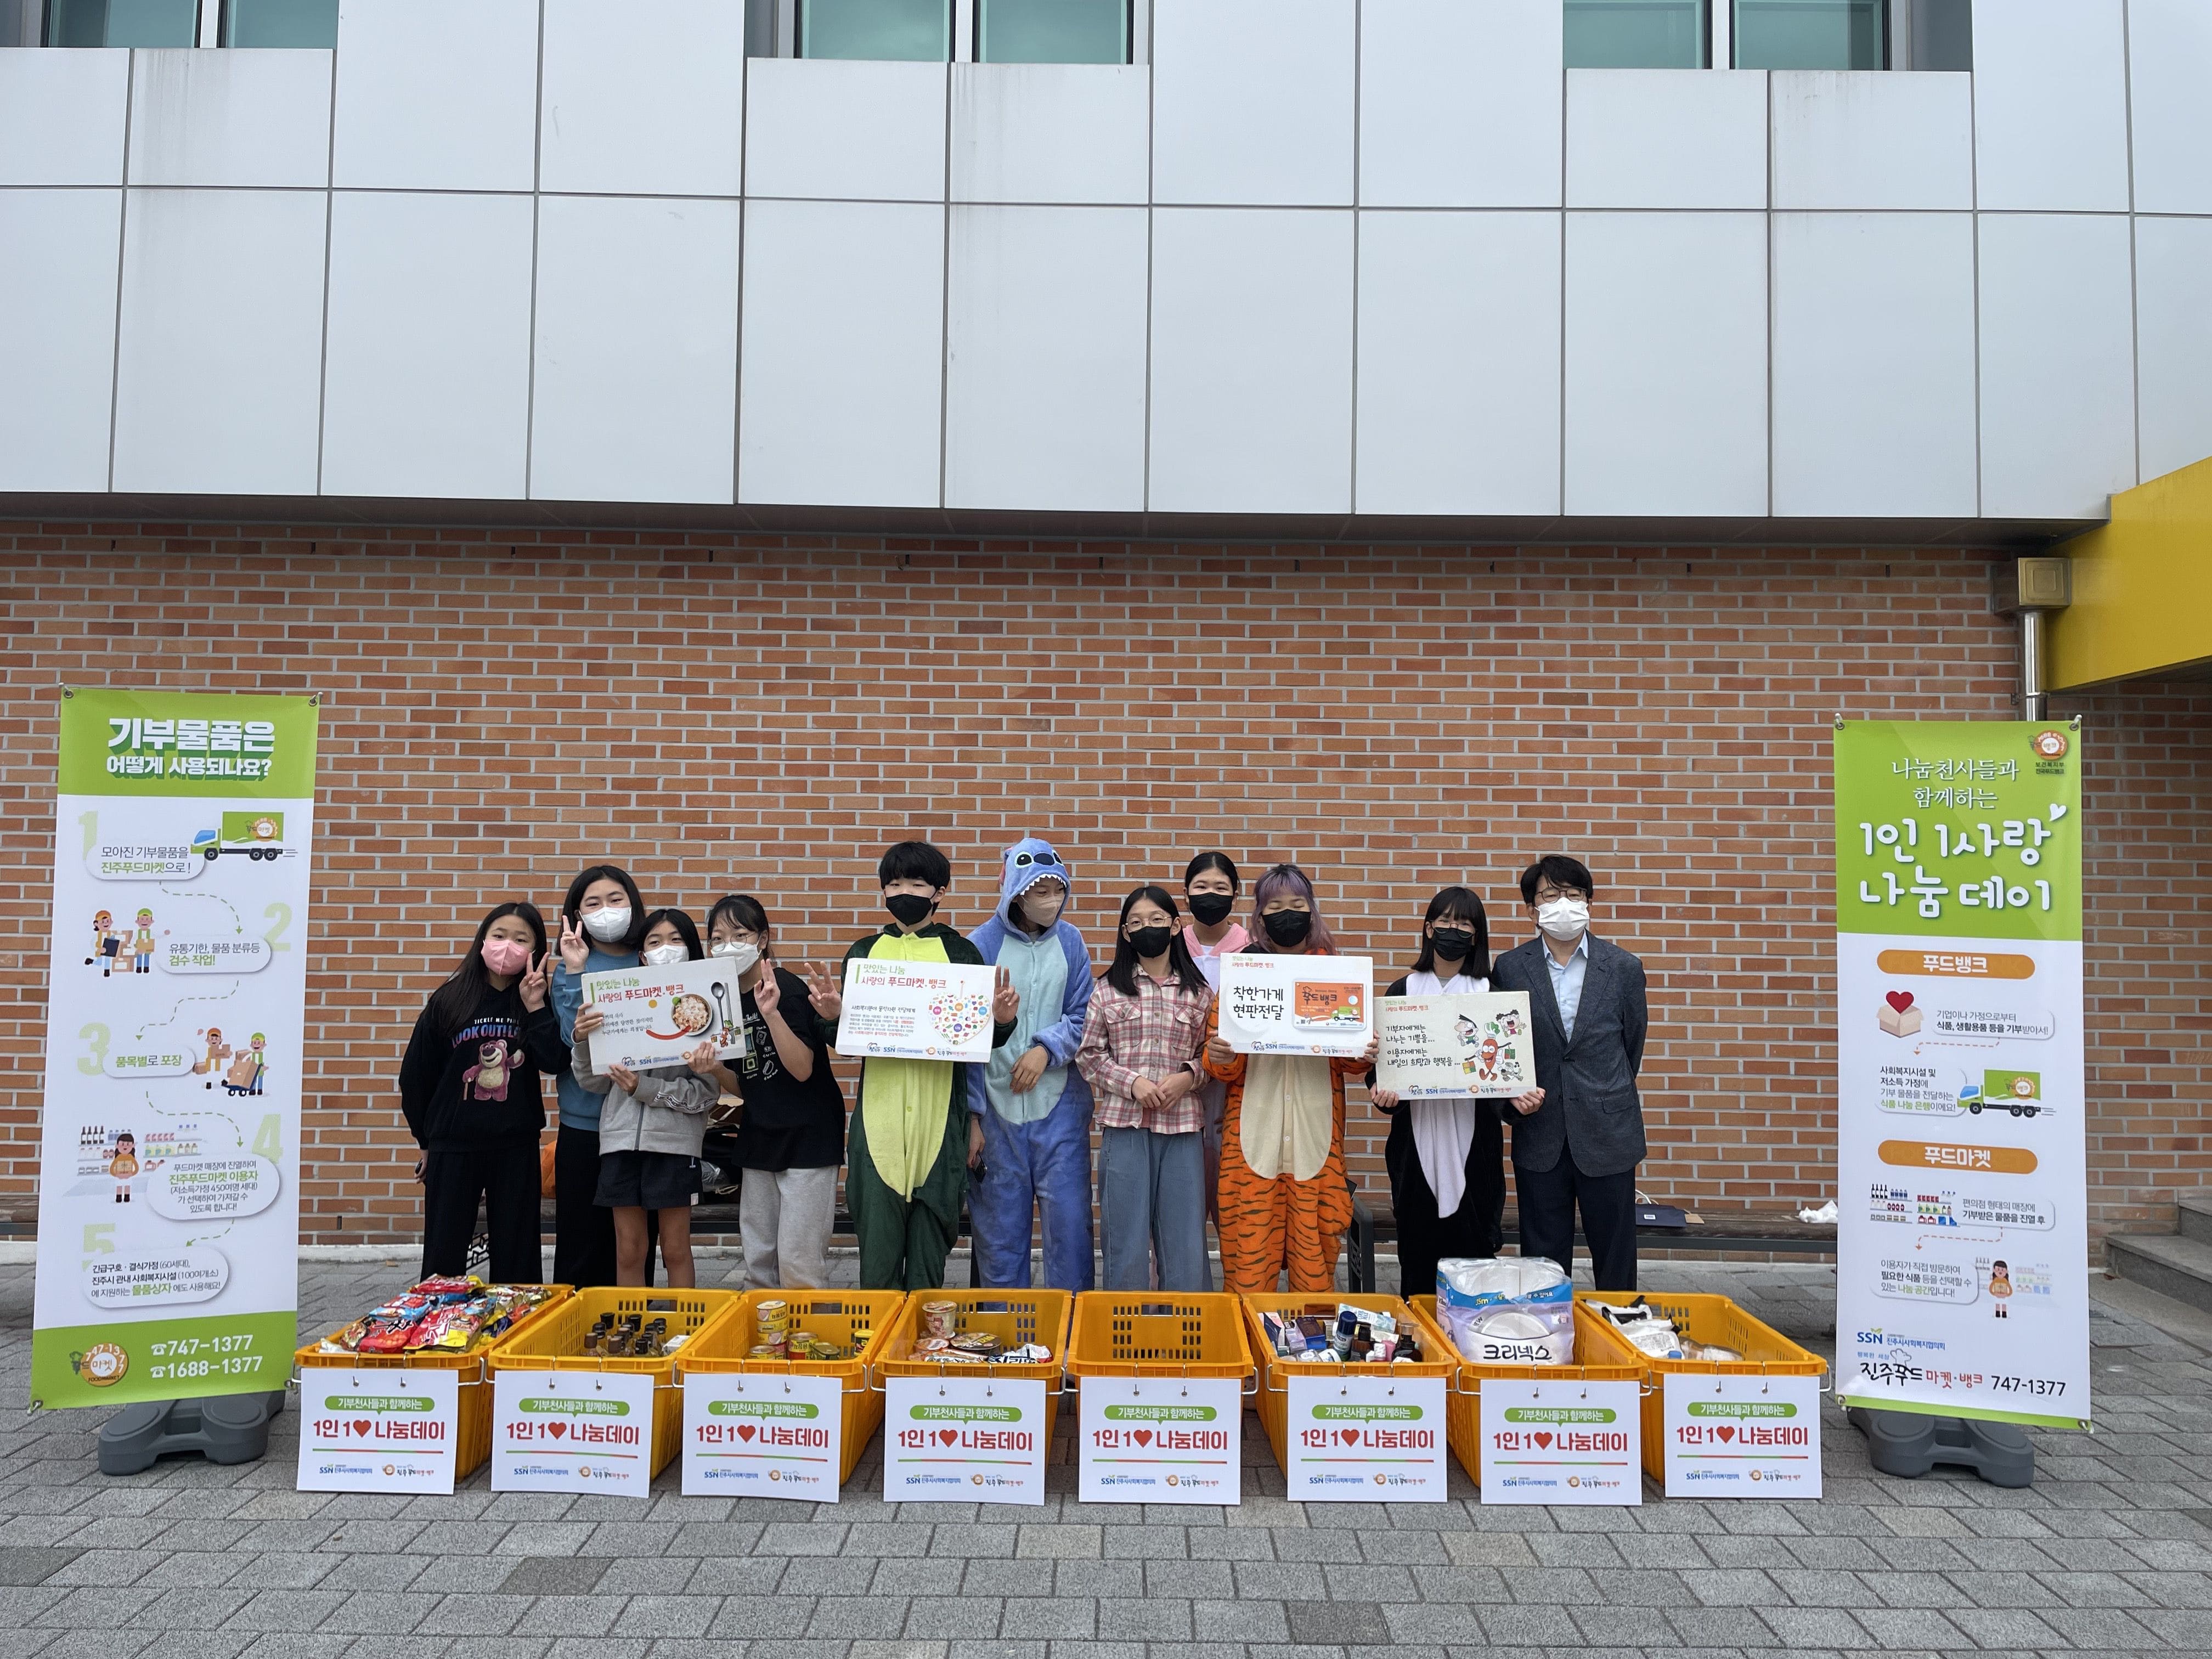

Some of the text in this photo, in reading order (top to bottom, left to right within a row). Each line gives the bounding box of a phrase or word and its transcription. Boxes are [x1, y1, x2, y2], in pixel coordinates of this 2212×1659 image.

[108, 718, 275, 753] 기부물품은
[107, 757, 272, 776] 어떻게 사용되나요?
[1892, 758, 2019, 781] 나눔천사들과
[1913, 787, 1999, 809] 함께하는
[1860, 818, 2051, 866] 1인 1사랑
[101, 847, 189, 859] 모아진 기부물품을
[1860, 865, 2051, 918] 나눔 데이
[169, 943, 260, 954] 유통기한, 물품 분류등
[170, 955, 215, 966] 검수 작업!
[1923, 955, 1988, 973] 푸드뱅크
[864, 964, 905, 975] 맛있는 나눔
[597, 977, 640, 990] 맛있는 나눔
[861, 977, 885, 985] 사랑의
[598, 992, 622, 1003] 사랑의
[1233, 986, 1283, 1001] 착한가게
[1233, 1005, 1284, 1020] 현판전달
[1937, 1011, 2016, 1022] 기업이나 가정으로부터
[1386, 1024, 1426, 1033] 기부자에게는
[1937, 1021, 2048, 1035] 식품, 생활용품 등을 기부받아서!
[452, 1026, 479, 1048] LOOK
[1386, 1035, 1406, 1044] 나누는
[1387, 1048, 1427, 1057] 이용자에게는
[116, 1055, 182, 1068] 품목별로 포장
[1387, 1059, 1408, 1068] 내일의
[1410, 1058, 1431, 1066] 희망과
[1881, 1066, 1936, 1077] 사회복지시설 및
[1881, 1077, 1928, 1088] 저소득 가정에
[1881, 1088, 1895, 1098] 기부
[1898, 1089, 1921, 1099] 물품을
[1881, 1099, 1956, 1112] 식품 나눔 은행이에요!
[1925, 1146, 1991, 1168] 푸드마켓
[174, 1163, 202, 1172] 푸드마켓
[205, 1162, 226, 1171] 매장에
[169, 1170, 258, 1185] 진주푸드마켓 이용자
[178, 1195, 185, 1204] 가
[187, 1194, 216, 1204] 선택하여
[240, 1193, 248, 1201] 수
[1963, 1198, 2035, 1212] 편의점 형태의 매장에
[190, 1203, 237, 1214] 있도록 합니다!
[1963, 1210, 1994, 1221] 기부받은
[1995, 1212, 2018, 1222] 물품을
[2037, 1215, 2045, 1224] 후
[93, 1264, 122, 1274] 긴급구호
[1881, 1260, 1960, 1273] 이용자가 직접 방문하여
[92, 1274, 114, 1285] 진주시
[116, 1276, 131, 1284] 관내
[132, 1272, 177, 1283] 사회복지시설
[1881, 1271, 1972, 1287] 필요한 식품 등을 선택할 수
[101, 1288, 131, 1297] 지원하는
[132, 1283, 171, 1296] 물품상자
[1881, 1282, 1896, 1292] 있는
[1898, 1284, 1913, 1294] 나눔
[1857, 1332, 1882, 1344] SSN
[1887, 1338, 1945, 1350] 진주시사회복지협의회
[167, 1335, 253, 1356] 747-1377
[1483, 1344, 1552, 1361] 크리넥스
[167, 1356, 263, 1379] 1688-1377
[1991, 1375, 2066, 1396] 747-1377
[338, 1397, 422, 1410] 기부천사들과 함께하는
[533, 1400, 618, 1414] 기부천사들과 함께하는
[722, 1401, 806, 1417] 기부천사들과 함께하는
[1701, 1404, 1785, 1417] 기부천사들과 함께하는
[923, 1406, 1009, 1420] 기부천사들과 함께하는
[1118, 1407, 1204, 1419] 기부천사들과 함께하는
[1325, 1406, 1410, 1419] 기부천사들과 함께하는
[1519, 1409, 1604, 1422] 기부천사들과 함께하는
[313, 1420, 338, 1438] 1인
[506, 1421, 532, 1441] 1인
[696, 1425, 723, 1443] 1인
[1677, 1426, 1701, 1443] 1인
[898, 1430, 924, 1448] 1인
[1093, 1430, 1118, 1448] 1인
[1301, 1429, 1326, 1448] 1인
[1494, 1432, 1519, 1451] 1인
